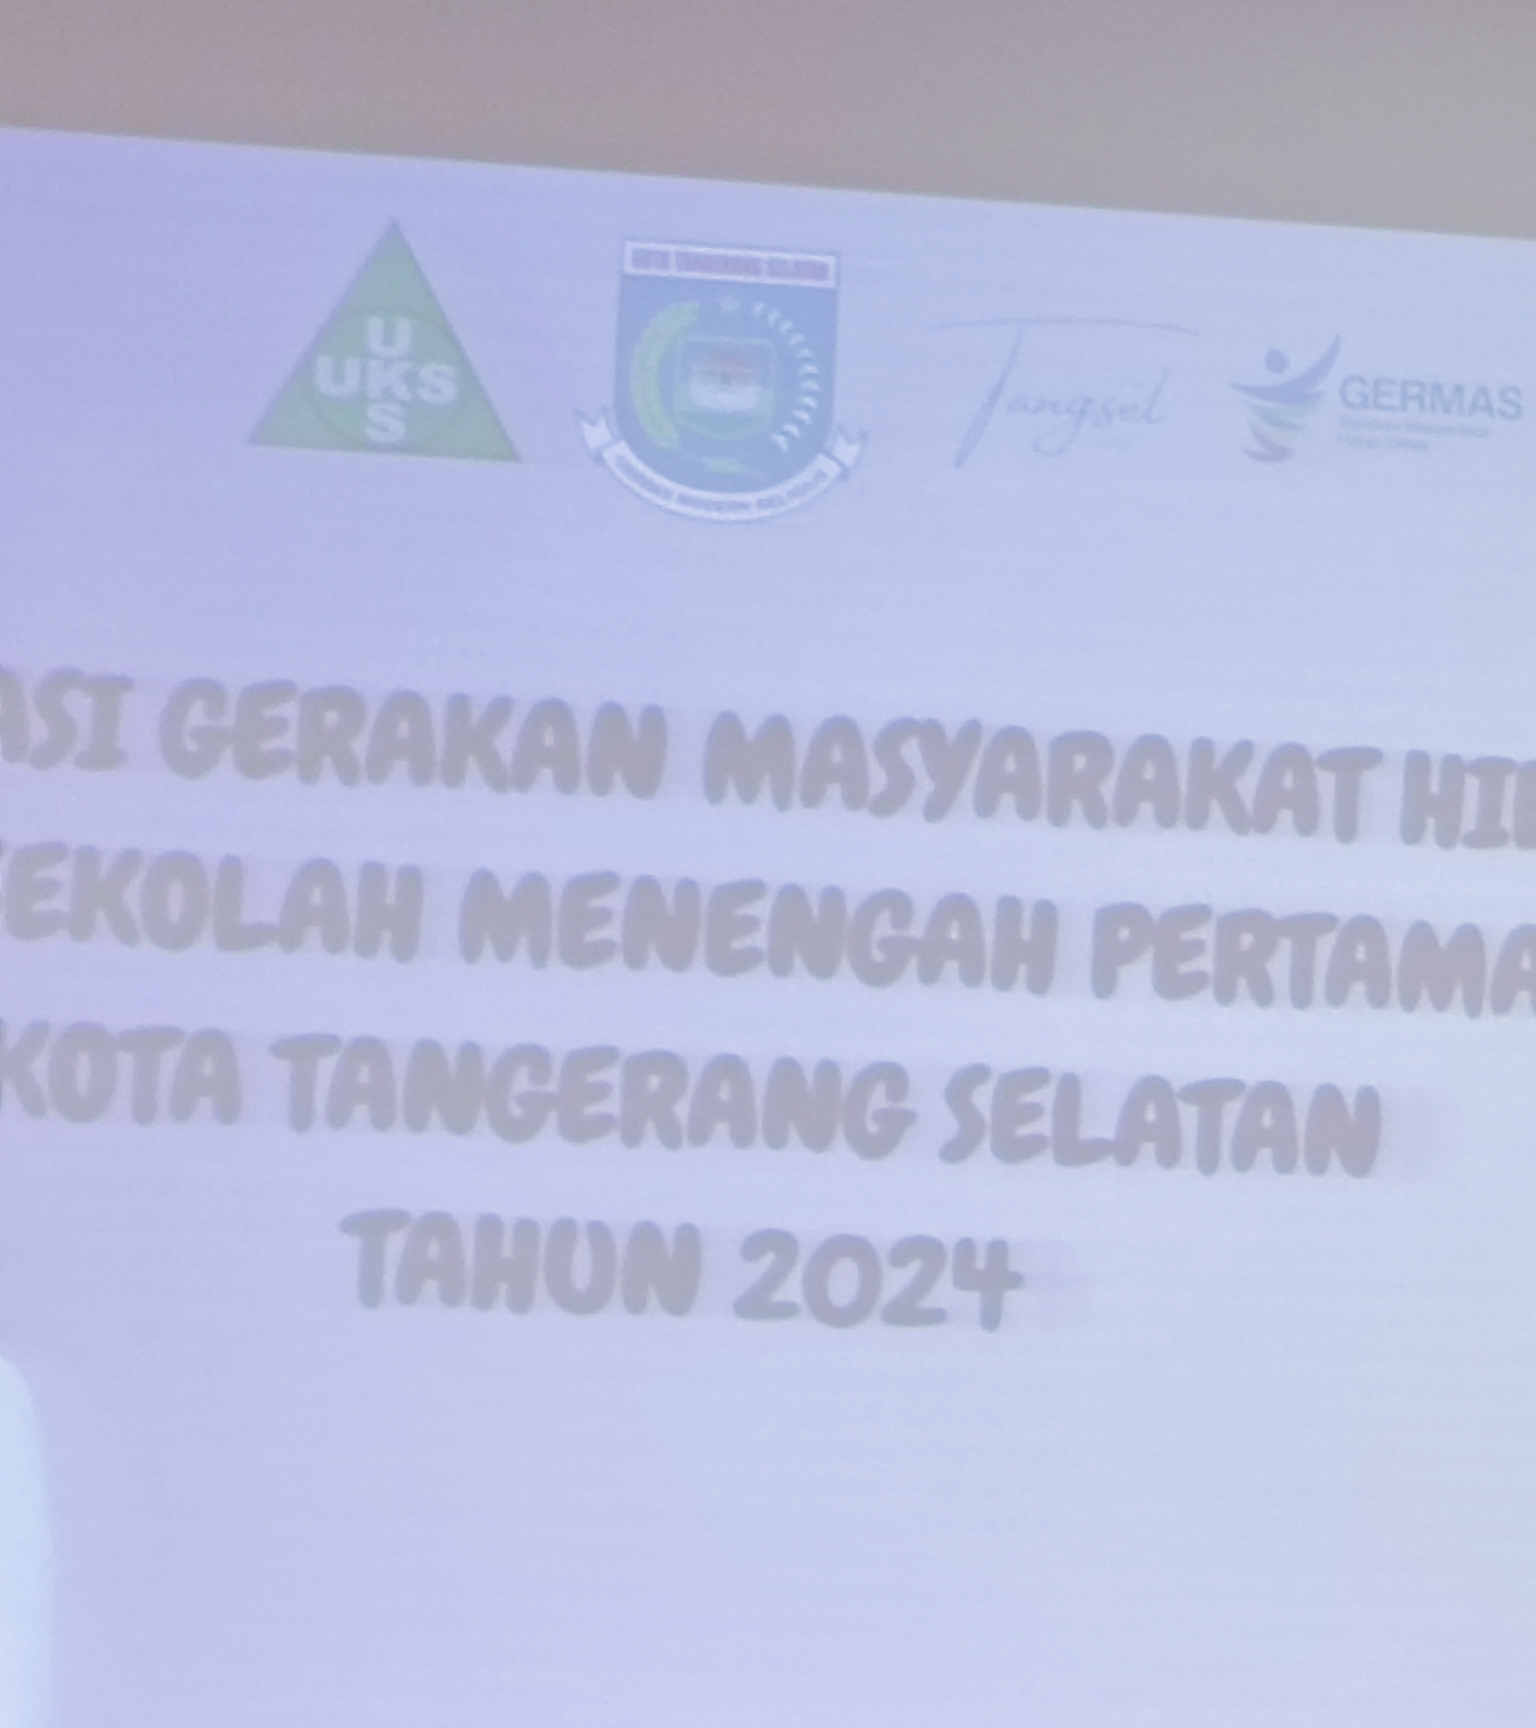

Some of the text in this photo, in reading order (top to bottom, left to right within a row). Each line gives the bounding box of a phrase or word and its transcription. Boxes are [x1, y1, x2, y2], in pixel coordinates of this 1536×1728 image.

[1338, 373, 1524, 420] GERMAS
[159, 675, 668, 801] GERAKAN
[703, 706, 1383, 843] MASYARAKAT
[0, 839, 424, 964] EKOLAH
[457, 866, 1057, 998] MENENGAH
[0, 1017, 1381, 1179] KOTA TANGERANG SELATAN
[336, 1206, 1022, 1333] TAHUN 2024
